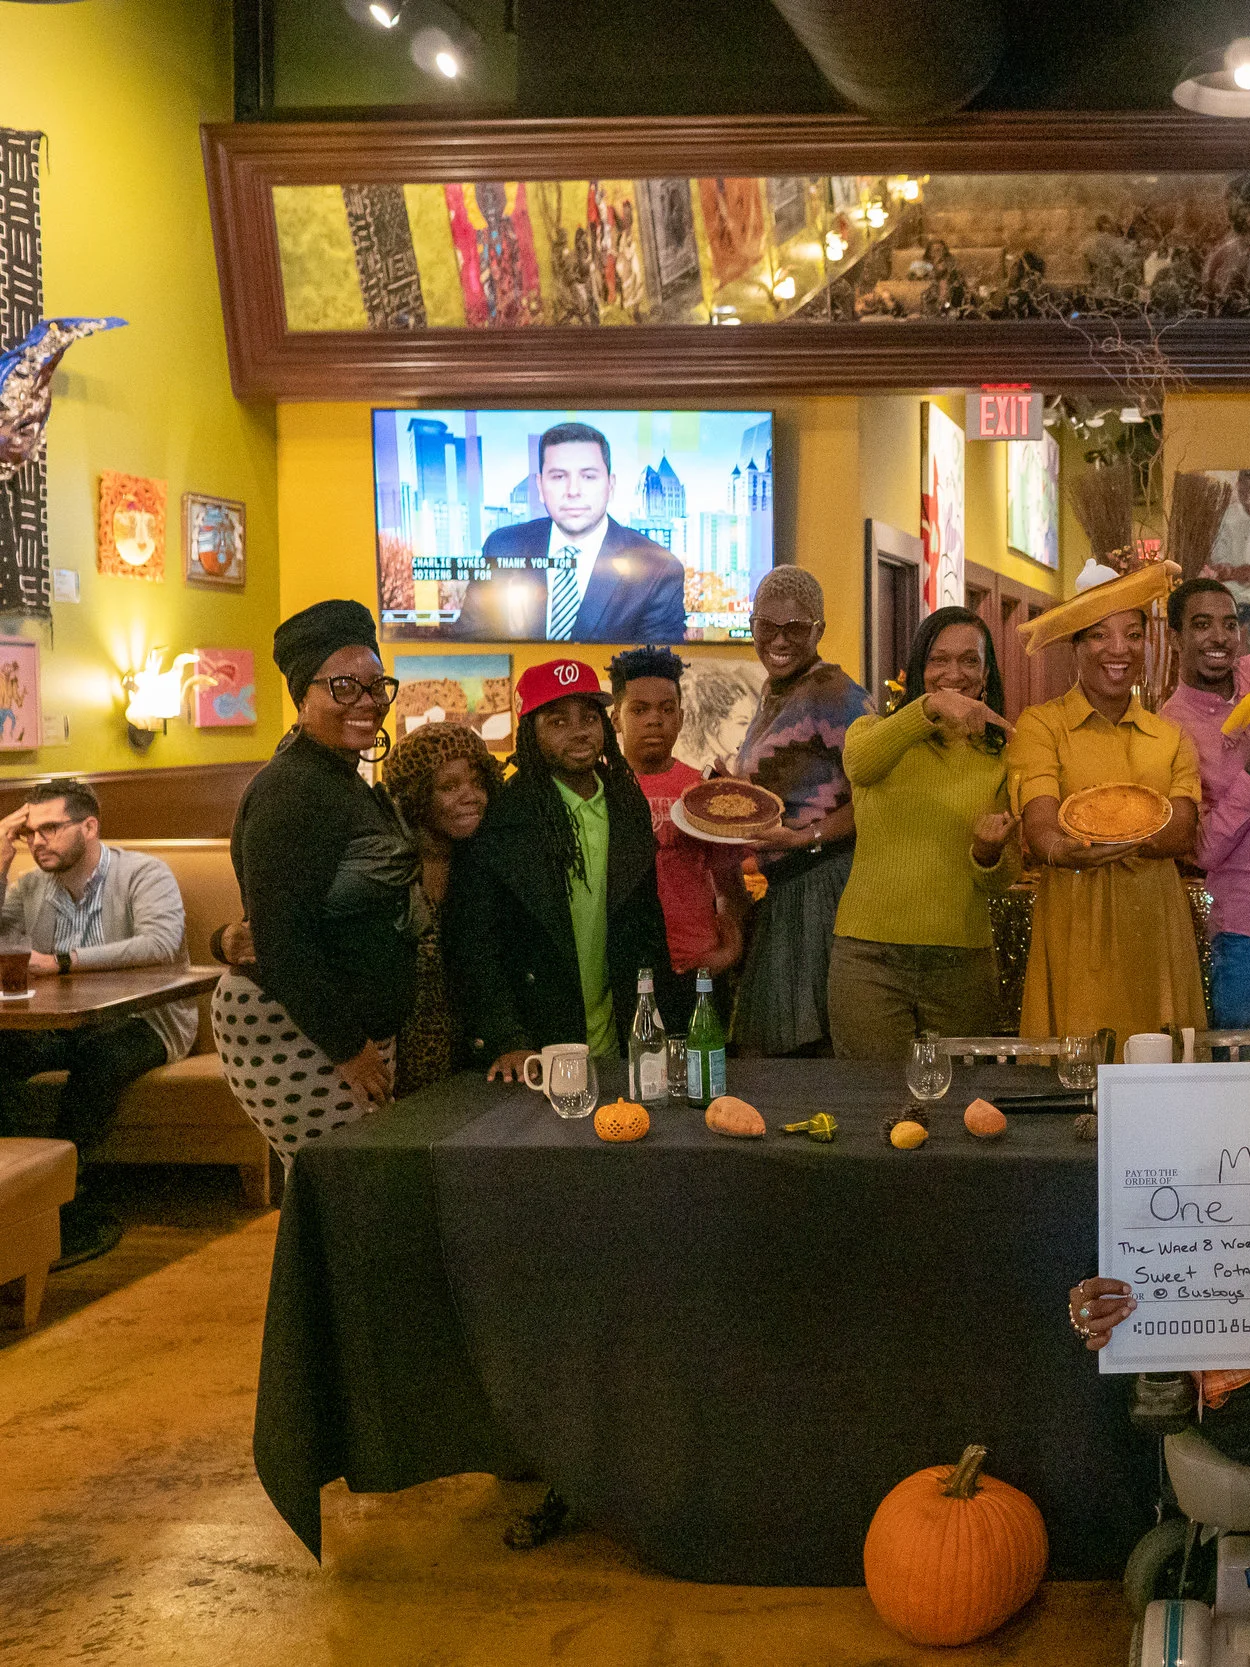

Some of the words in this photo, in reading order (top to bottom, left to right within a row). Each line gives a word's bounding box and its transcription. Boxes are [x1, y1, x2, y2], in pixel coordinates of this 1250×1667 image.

[980, 396, 1032, 436] EXIT
[412, 557, 451, 569] CHARLIE
[457, 557, 491, 570] SYKES,
[497, 557, 526, 569] THANK
[531, 557, 549, 569] YOU
[554, 557, 572, 569] FOR
[412, 569, 452, 581] JOINING
[457, 569, 470, 581] US
[474, 569, 492, 581] FOR
[704, 612, 751, 629] MSNB
[553, 663, 580, 686] W
[1125, 1169, 1143, 1178] PAY
[1144, 1169, 1157, 1177] TO
[1159, 1168, 1179, 1177] THE
[1125, 1177, 1157, 1186] ORDER
[1159, 1177, 1172, 1185] OF
[1150, 1186, 1233, 1224] One
[1118, 1242, 1154, 1255] The
[1203, 1239, 1213, 1252] 8
[1134, 1265, 1197, 1285] Sweet
[1178, 1286, 1245, 1304] Busboys
